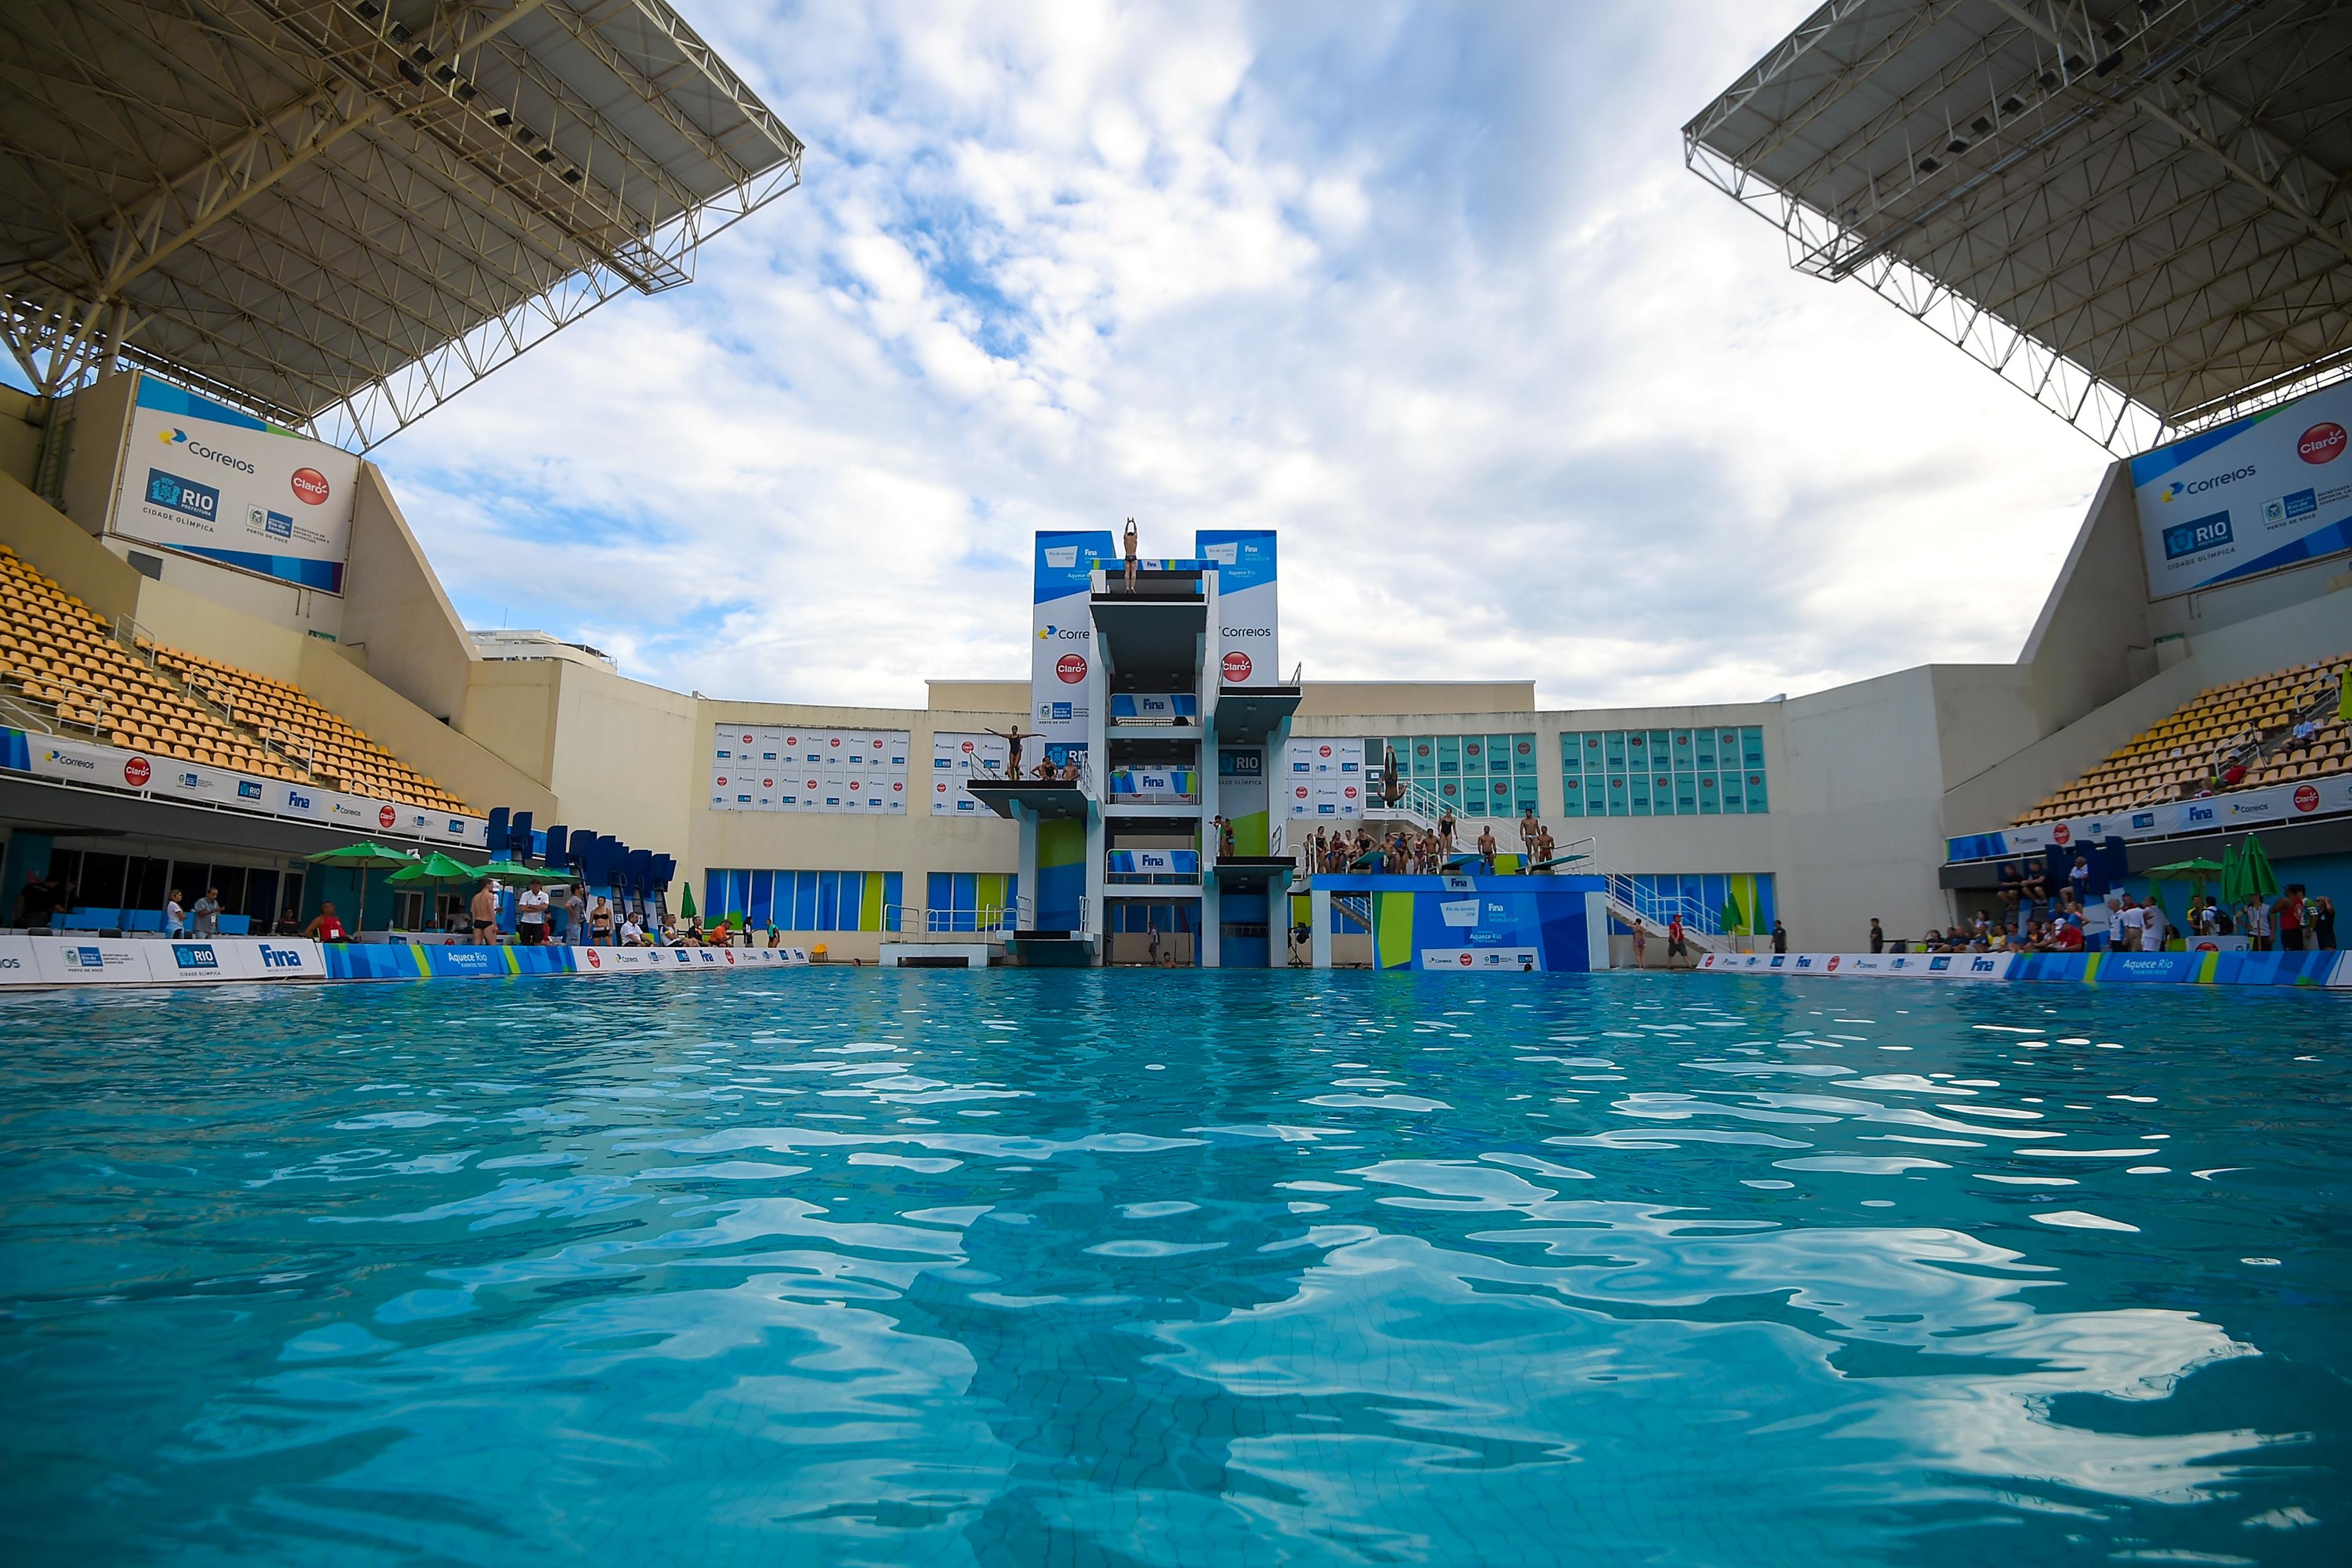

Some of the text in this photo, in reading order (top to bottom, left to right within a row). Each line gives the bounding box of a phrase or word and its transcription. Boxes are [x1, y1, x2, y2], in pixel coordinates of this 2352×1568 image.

[2300, 435, 2339, 454] Claro
[189, 442, 255, 474] Correios
[2187, 465, 2256, 494] Correios
[293, 478, 324, 494] Claro
[182, 489, 214, 511] RIO
[181, 504, 211, 516] PREFEITURA
[2288, 505, 2314, 516] Janeiro
[143, 507, 214, 533] CIDADE OLÍMPICA
[2196, 521, 2226, 541] RIO
[2267, 522, 2287, 531] PERTO
[247, 528, 264, 537] PERTO
[2168, 558, 2195, 570] CIDADE
[1058, 630, 1090, 639] Corre
[1222, 627, 1270, 636] Correios
[1143, 698, 1164, 709] Fina
[60, 756, 94, 769] Correios
[1237, 757, 1258, 768] RIO
[126, 766, 146, 776] Claro
[1143, 775, 1164, 787] Fina
[249, 786, 260, 795] RIO
[288, 791, 310, 809] Fina
[2295, 794, 2316, 804] Claro
[340, 807, 361, 816] Correios
[2190, 807, 2212, 821] Fina
[2241, 804, 2268, 813] Correios
[1142, 854, 1163, 865] Fina
[1451, 878, 1467, 887] Fina
[194, 951, 213, 961] RIO
[258, 944, 302, 967] Fina
[448, 952, 487, 964] Aquece Rio
[1971, 956, 1995, 971] Fina
[2123, 959, 2173, 970] Aquece Rio
